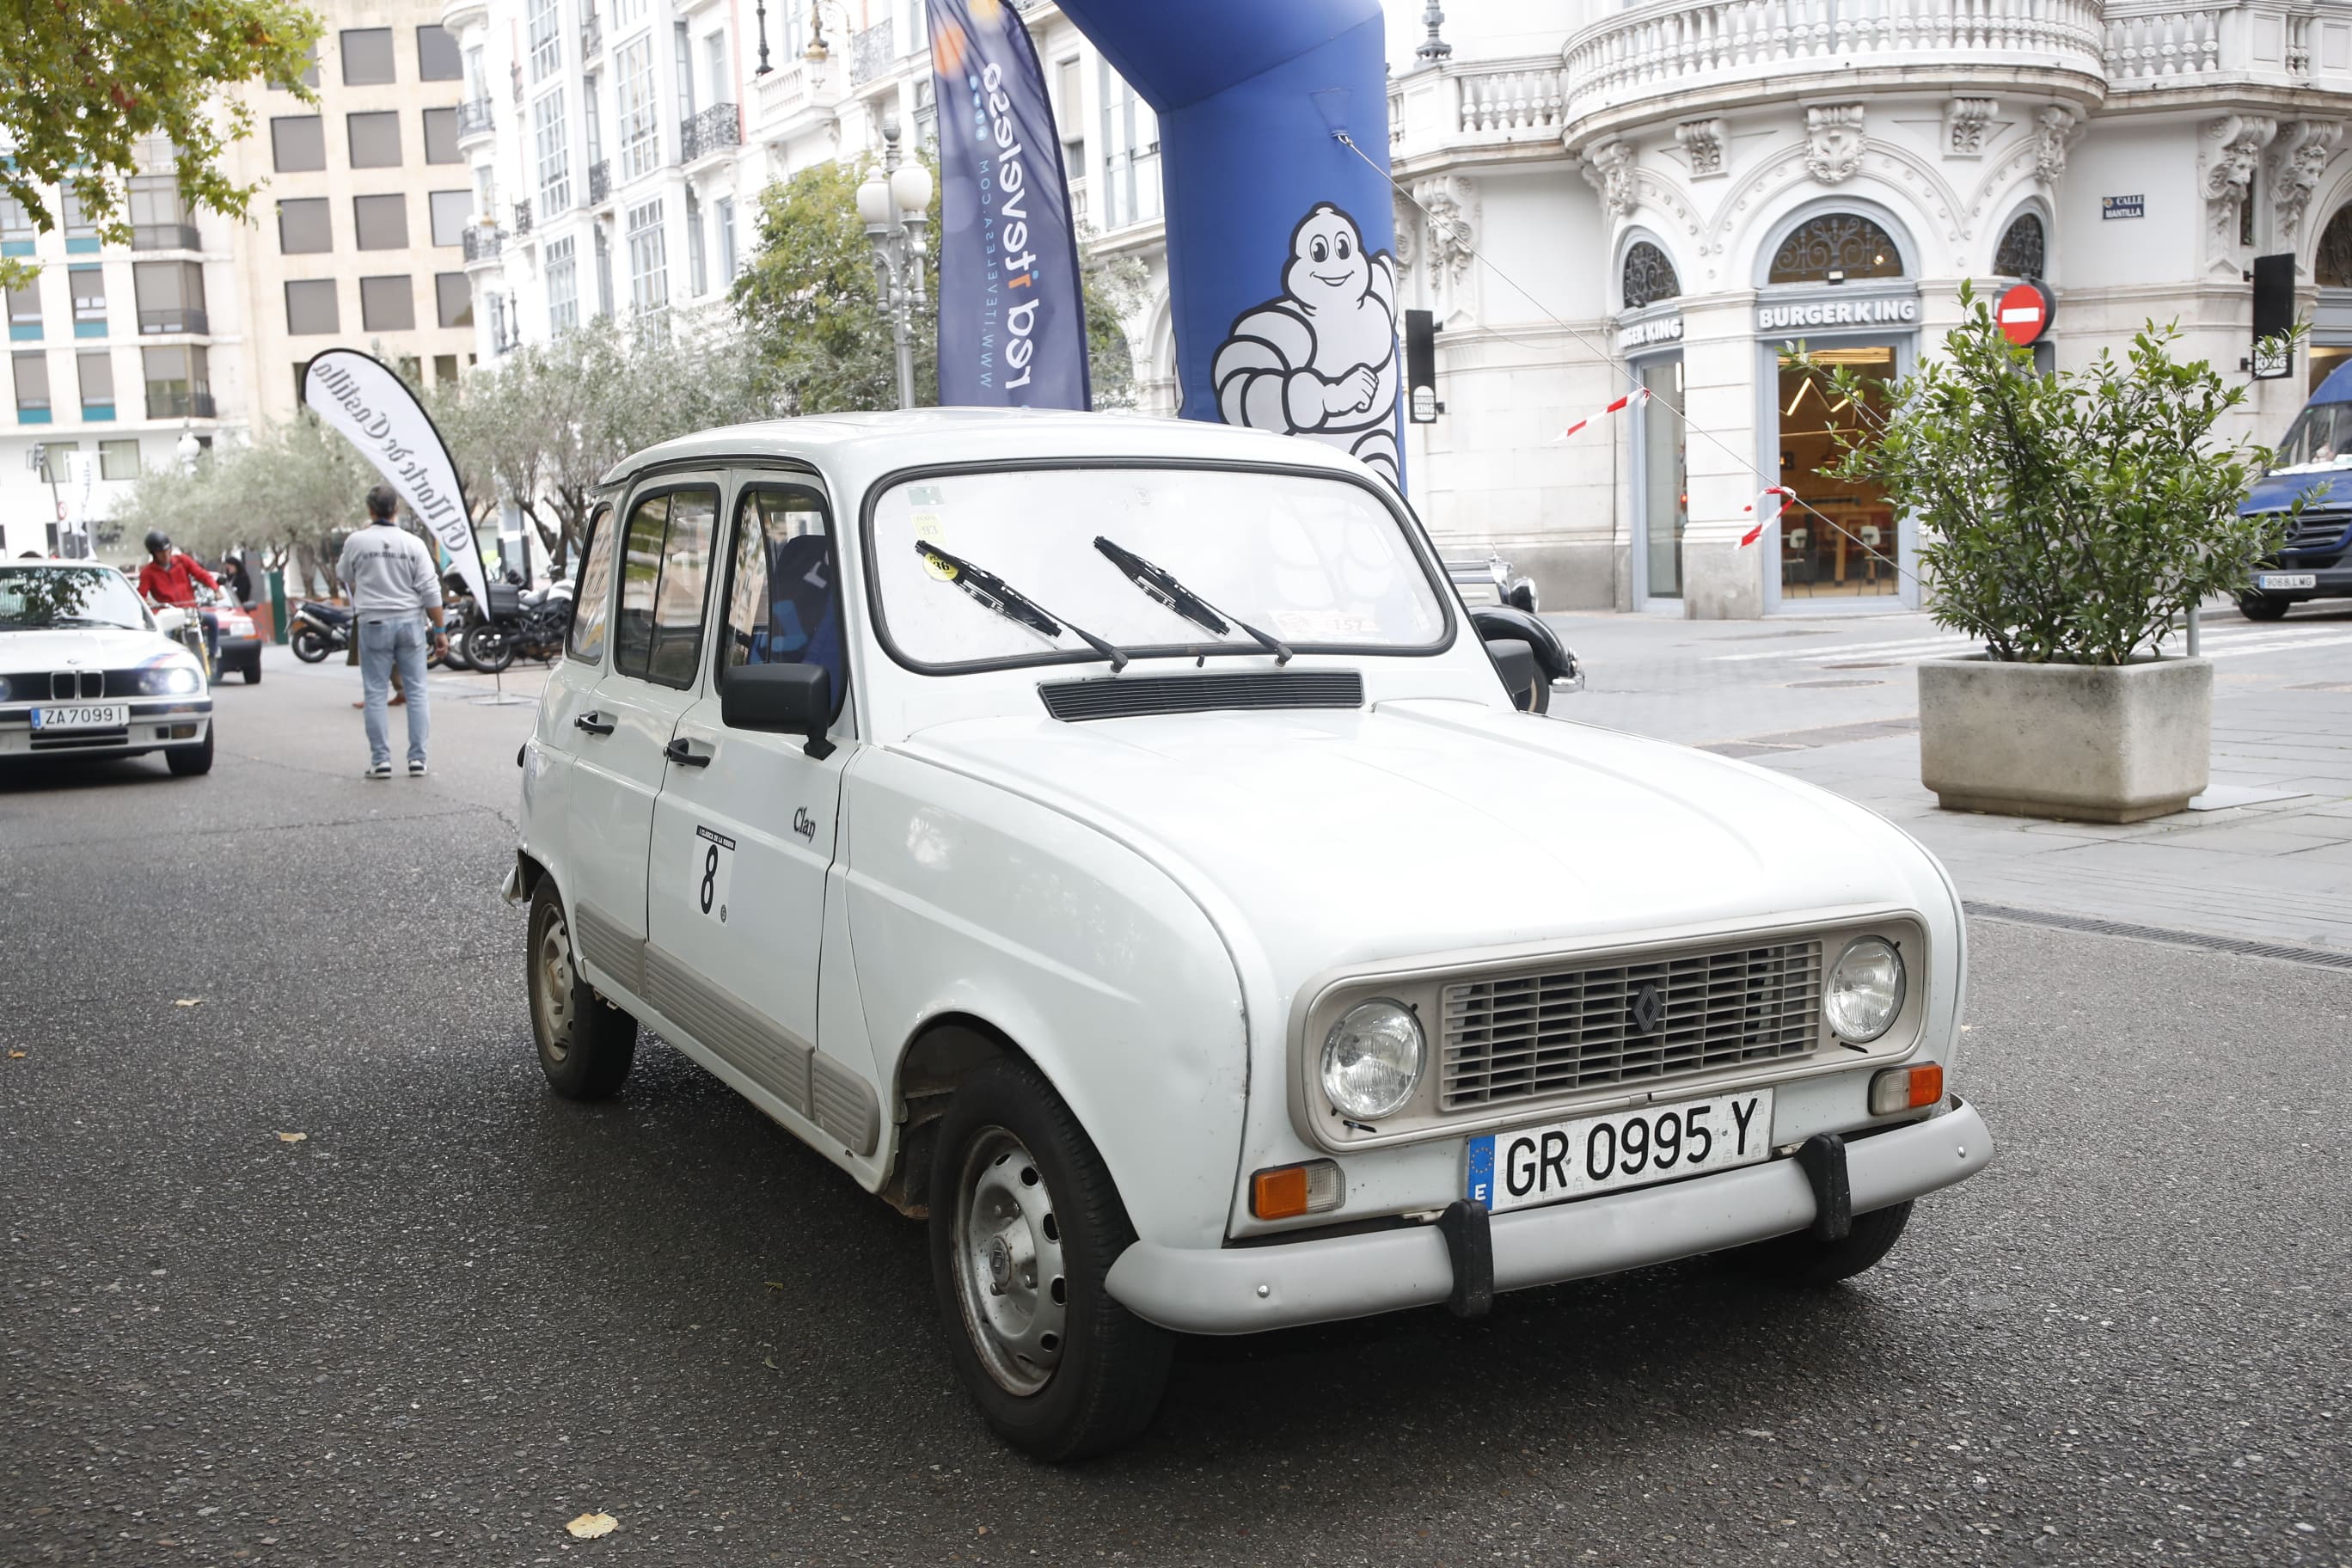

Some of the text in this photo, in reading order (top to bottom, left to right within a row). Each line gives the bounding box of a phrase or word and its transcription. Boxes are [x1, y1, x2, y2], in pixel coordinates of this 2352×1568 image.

[2116, 196, 2142, 205] CALLE
[2106, 207, 2141, 217] MANTILLA
[1759, 300, 1915, 328] BURGER KING
[1645, 318, 1681, 341] KING
[1414, 403, 1435, 413] KING
[2292, 577, 2312, 585] LMG
[46, 710, 65, 725] ZA
[69, 707, 113, 723] 7099
[793, 806, 816, 843] Clan
[701, 844, 718, 915] 8
[1507, 1098, 1758, 1197] GR 0995 Y
[1474, 1184, 1486, 1201] E
